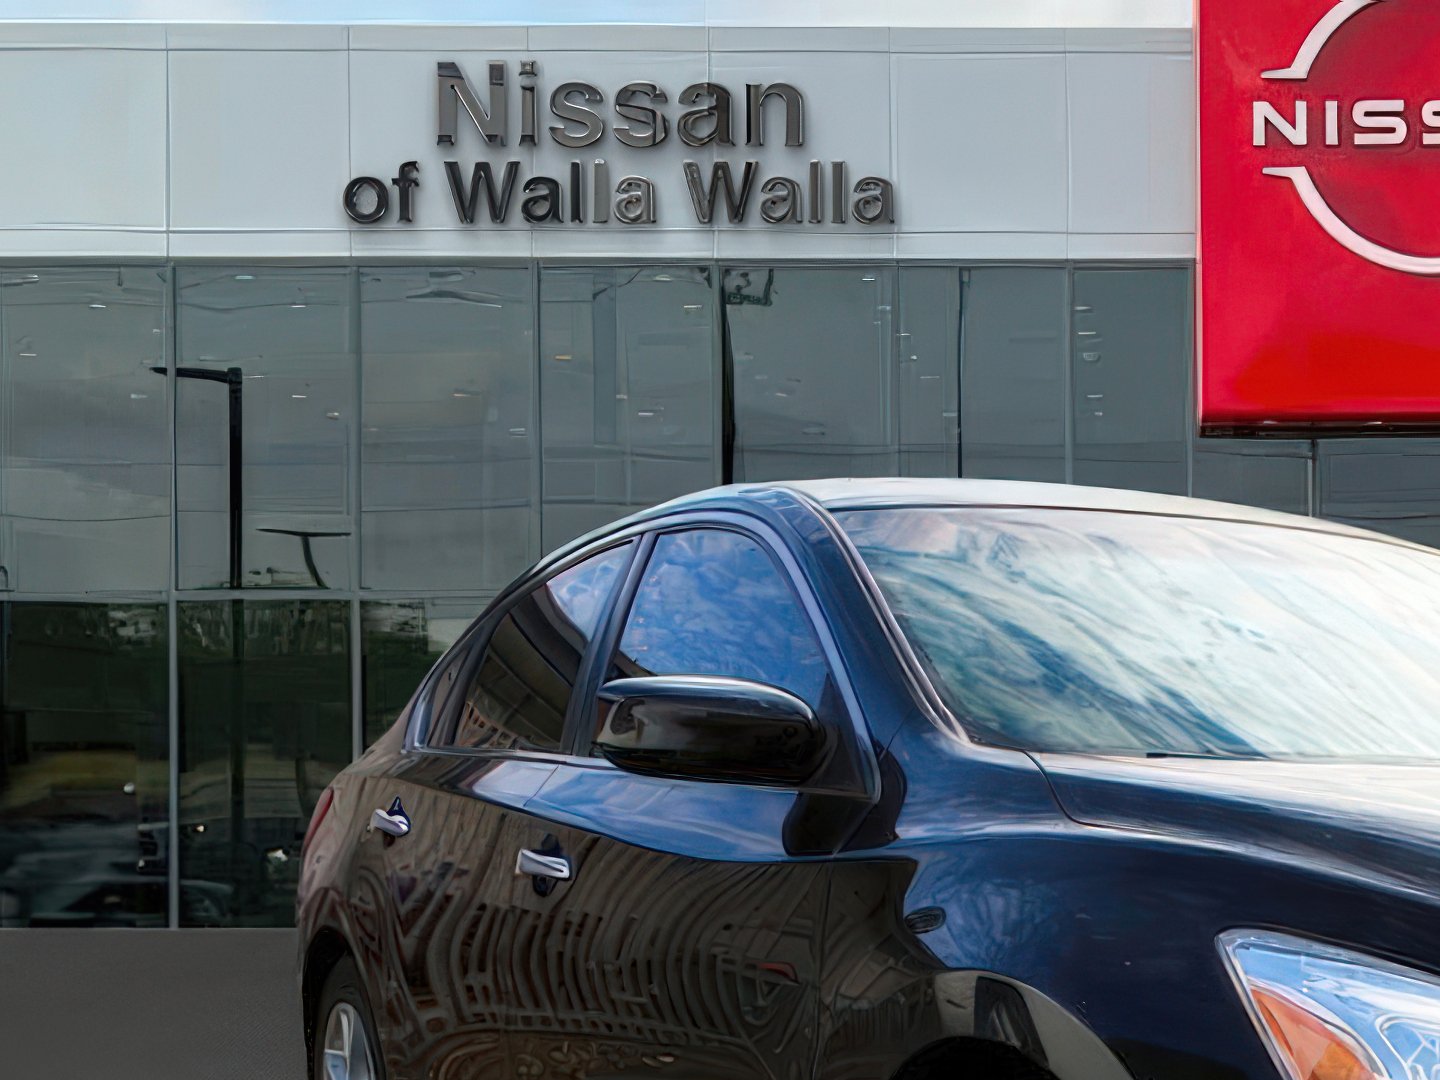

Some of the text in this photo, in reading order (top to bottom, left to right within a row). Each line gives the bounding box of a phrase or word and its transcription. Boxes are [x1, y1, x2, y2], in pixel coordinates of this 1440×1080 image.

[436, 59, 805, 148] Nissan
[343, 159, 896, 225] of Walla Walla
